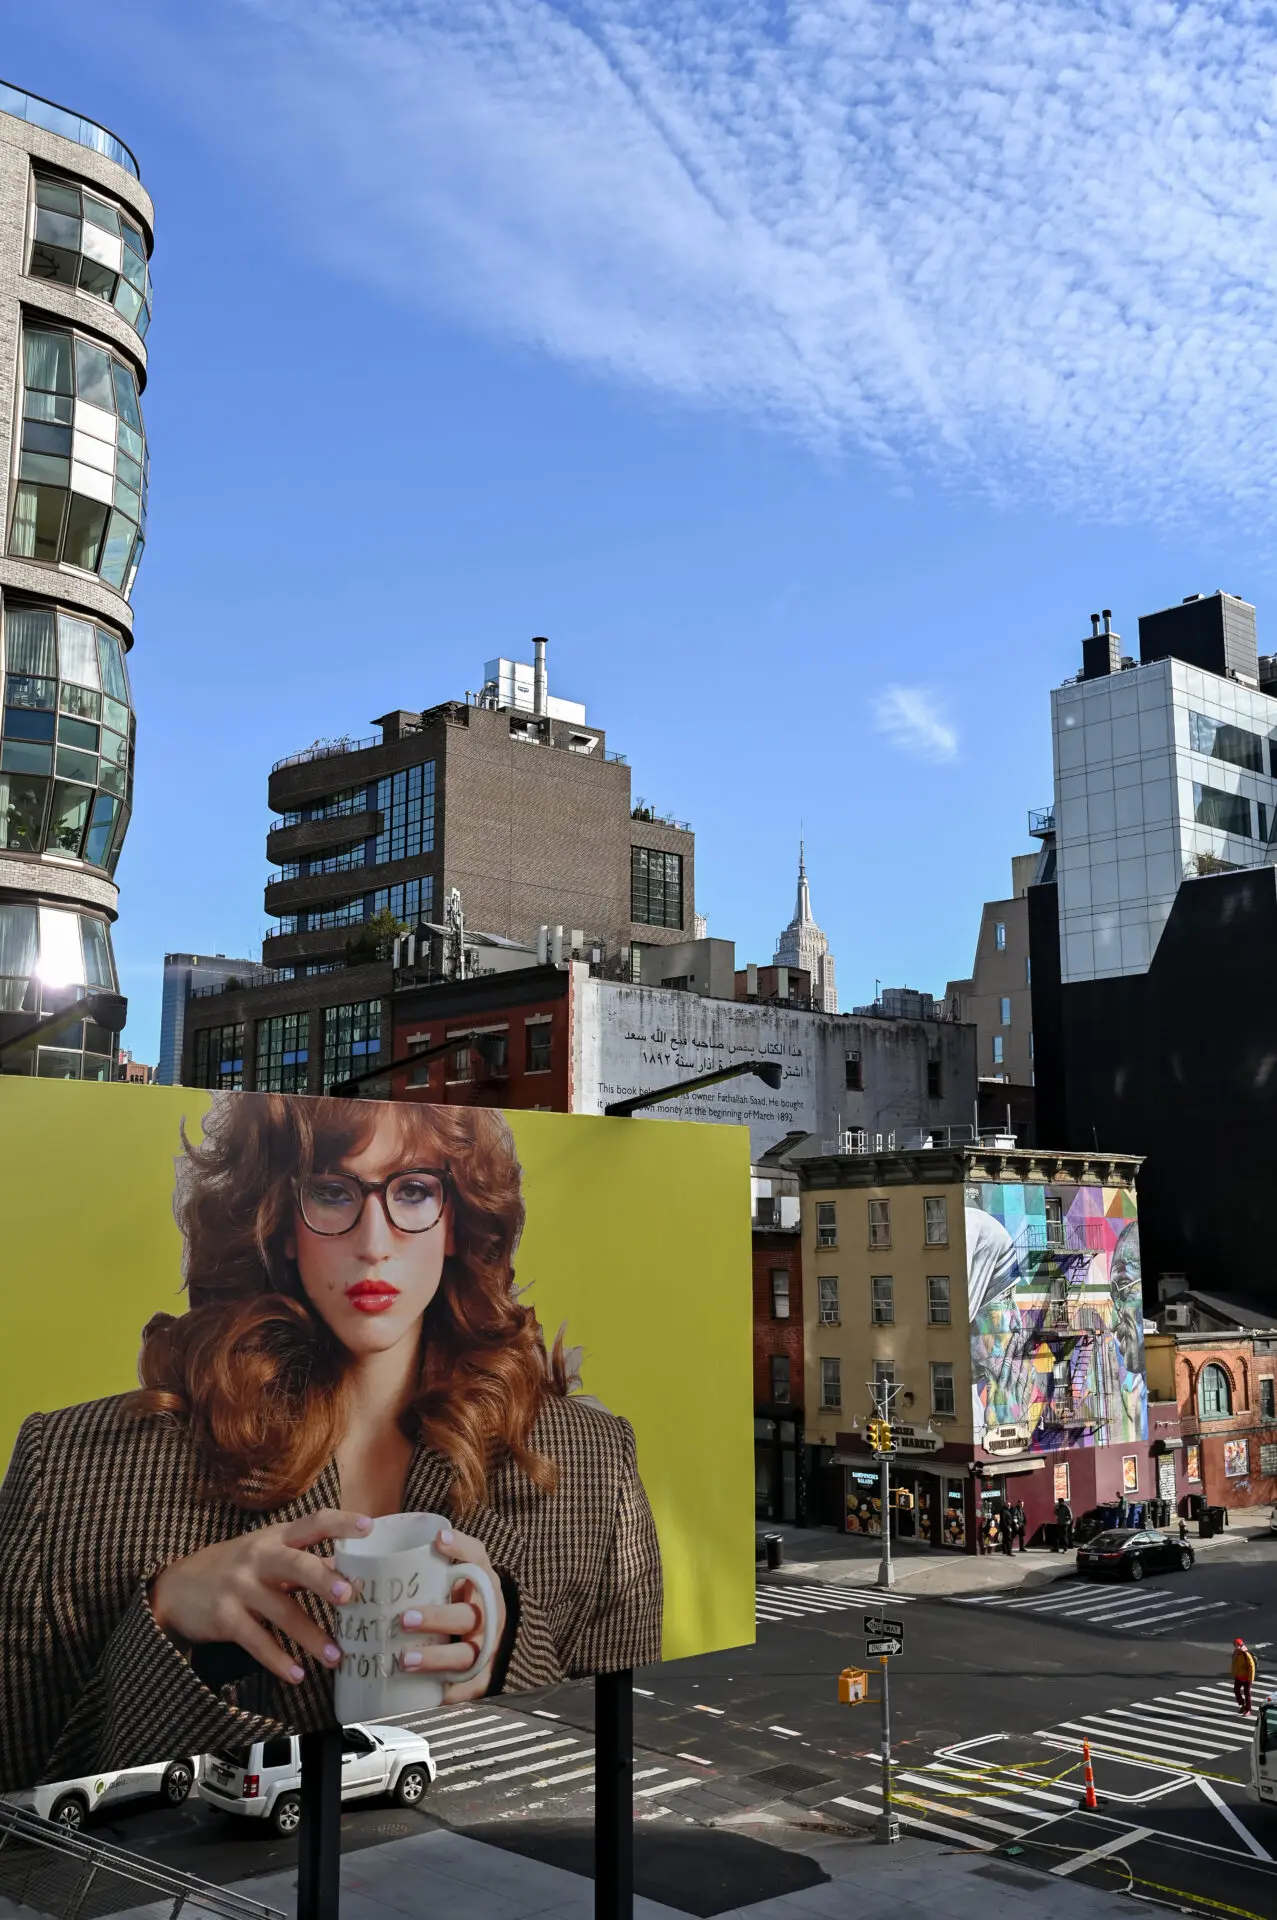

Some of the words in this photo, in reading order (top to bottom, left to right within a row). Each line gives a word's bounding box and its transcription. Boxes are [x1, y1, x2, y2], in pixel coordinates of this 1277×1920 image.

[192, 956, 197, 965] 1
[650, 1026, 666, 1043] الله
[643, 1051, 670, 1065] ١٨٩٢
[598, 1082, 614, 1094] This
[616, 1084, 637, 1095] book
[692, 1093, 715, 1101] owner
[717, 1092, 747, 1104] Fathallah
[769, 1098, 779, 1106] He
[780, 1098, 804, 1111] bought
[597, 1099, 603, 1109] it
[657, 1106, 683, 1115] money
[694, 1107, 707, 1115] the
[708, 1107, 742, 1121] beginning
[743, 1110, 752, 1119] of
[752, 1110, 775, 1121] March
[886, 1624, 899, 1633] WAY
[871, 1643, 882, 1651] ONE
[886, 1642, 898, 1651] WAY
